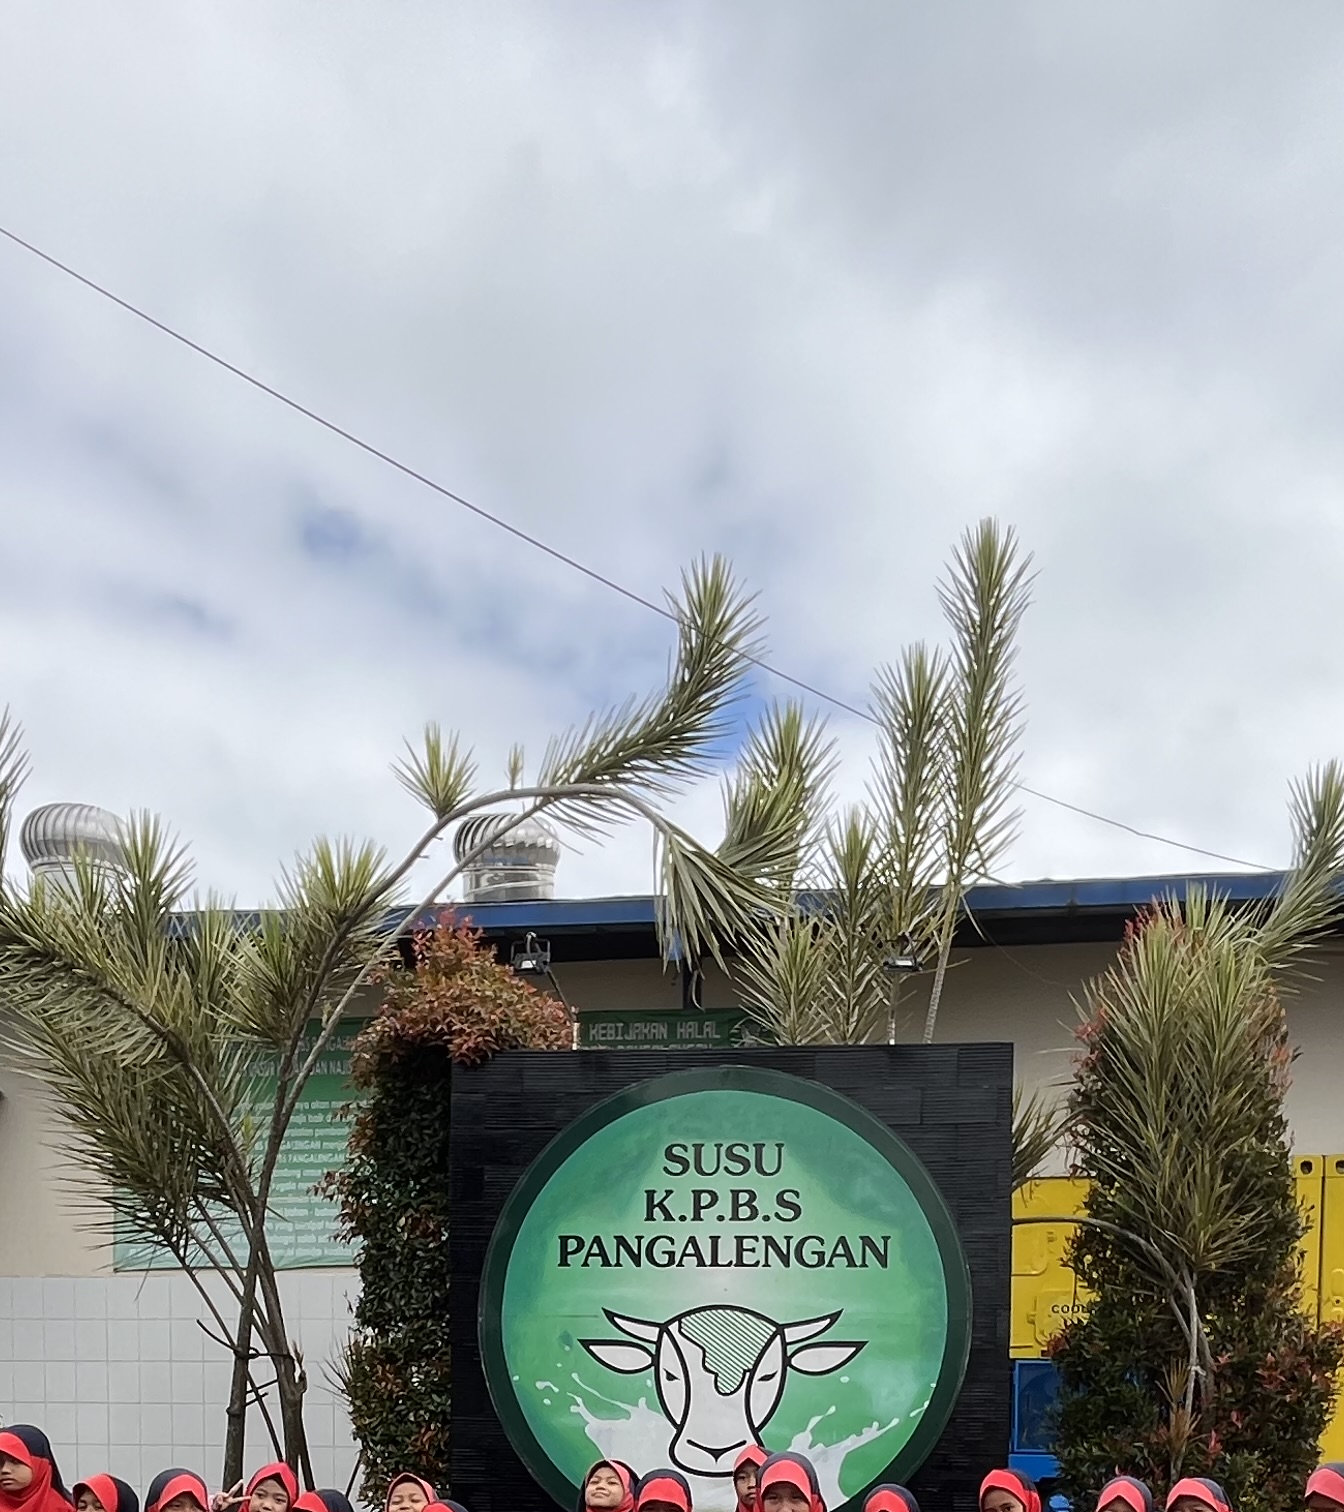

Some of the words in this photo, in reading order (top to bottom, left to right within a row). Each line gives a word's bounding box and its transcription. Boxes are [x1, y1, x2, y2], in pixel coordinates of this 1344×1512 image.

[589, 1021, 667, 1041] KEBIJAKAN
[677, 1021, 721, 1039] HALAL
[662, 1142, 785, 1177] SUSU
[643, 1189, 803, 1222] K.P.B.S
[557, 1235, 892, 1269] PANGALENGAN
